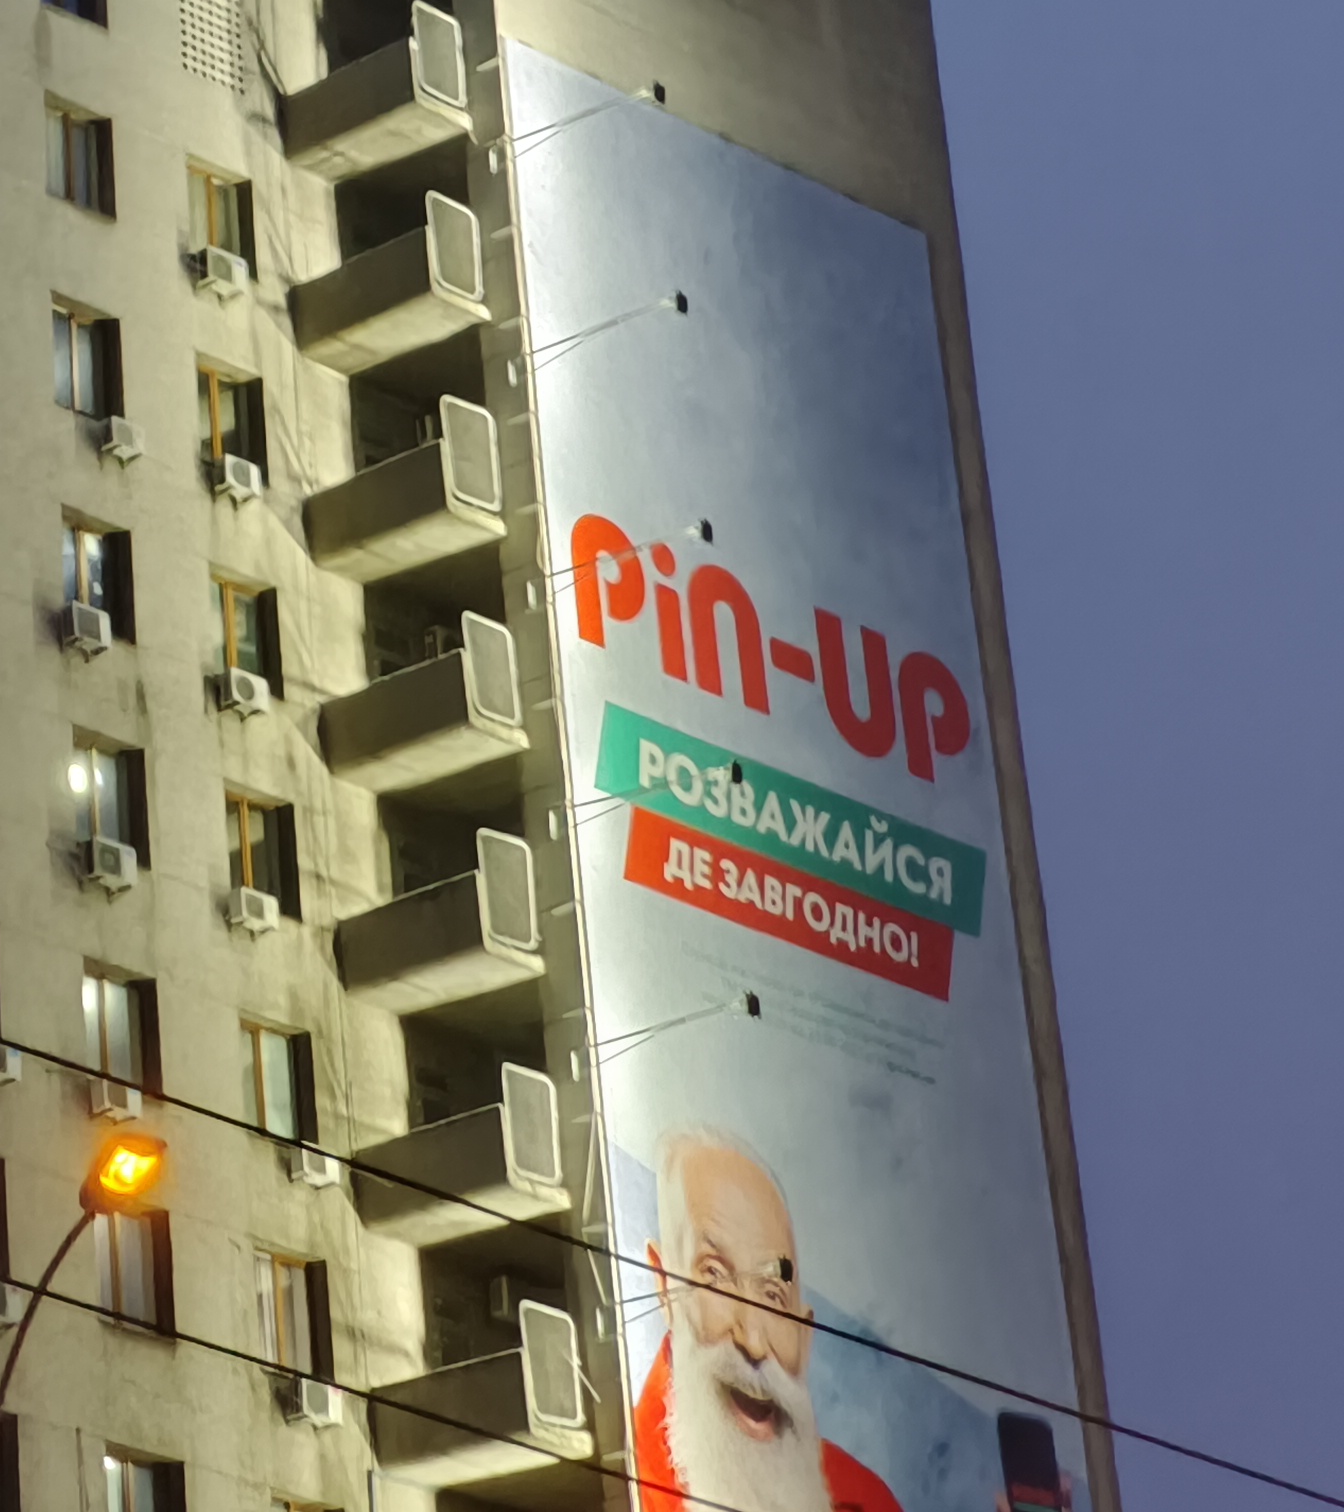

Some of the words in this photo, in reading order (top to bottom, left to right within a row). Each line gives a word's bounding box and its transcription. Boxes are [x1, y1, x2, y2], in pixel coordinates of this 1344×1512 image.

[638, 737, 953, 906] РОЗВАЖАЙСЯ
[663, 836, 713, 891] ДЕ
[718, 858, 919, 968] ЗАВГОДНО!
